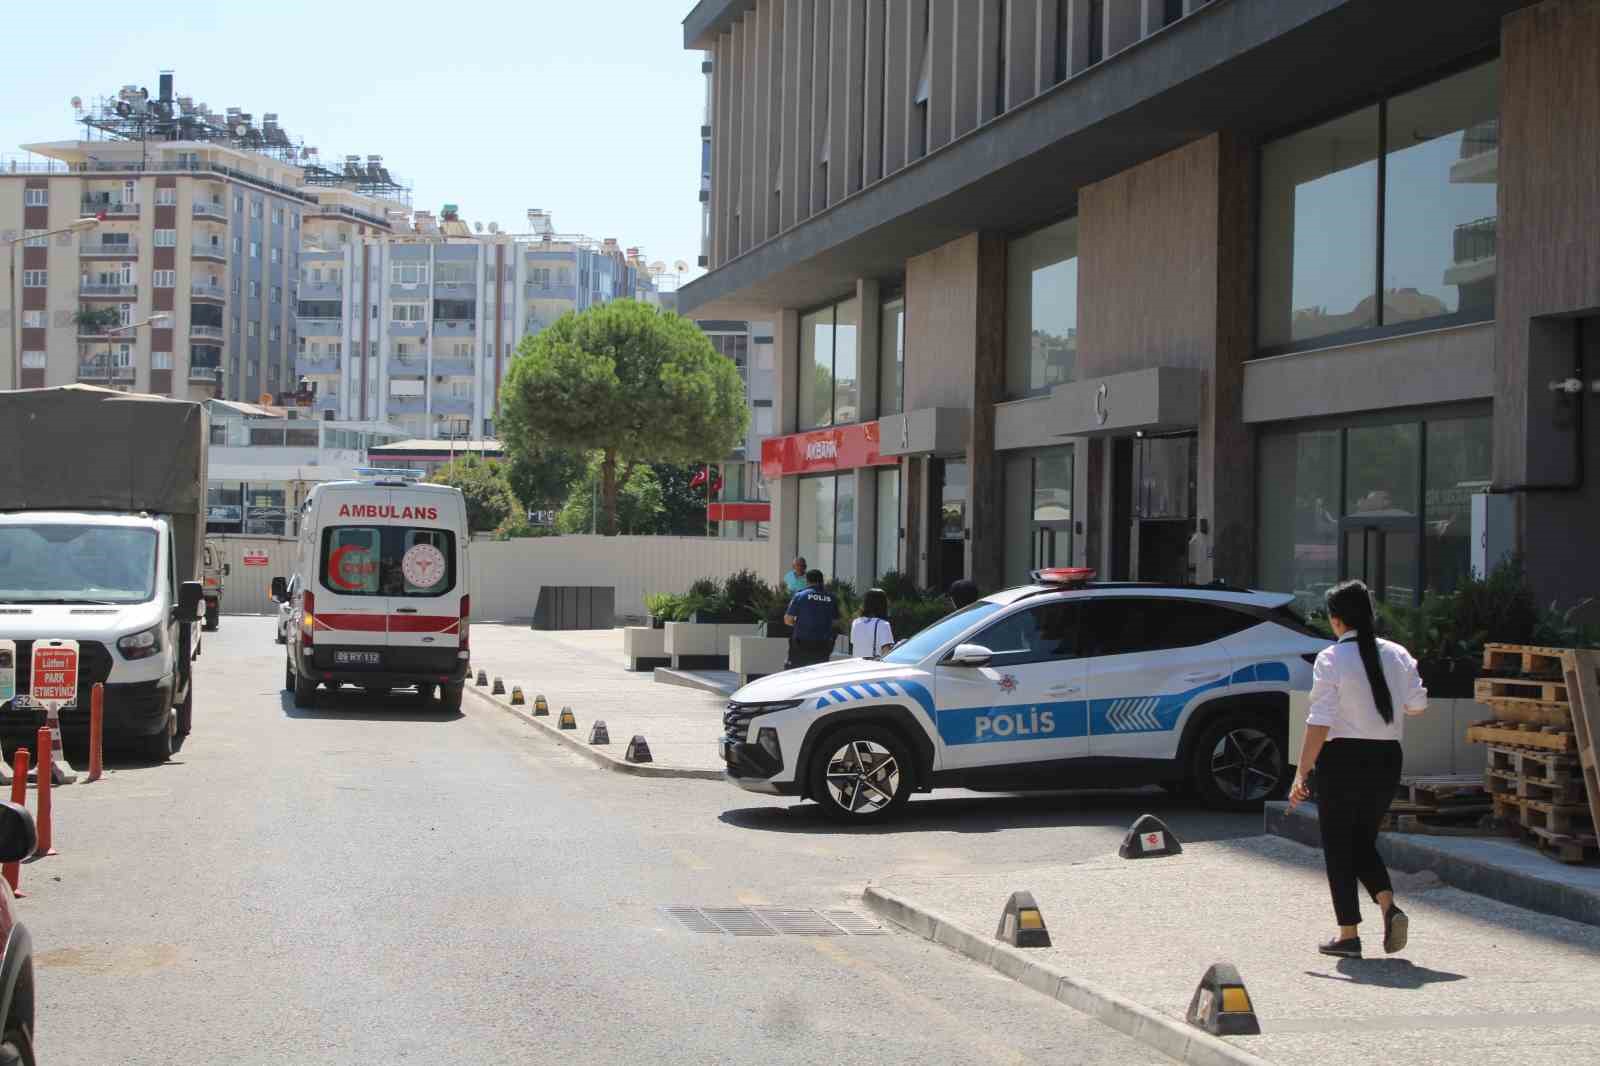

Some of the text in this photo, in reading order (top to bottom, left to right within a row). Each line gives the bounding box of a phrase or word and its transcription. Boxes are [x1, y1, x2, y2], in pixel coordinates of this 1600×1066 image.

[338, 503, 438, 520] AMBULANS
[44, 672, 64, 684] PARK
[975, 707, 1055, 737] POLİS
